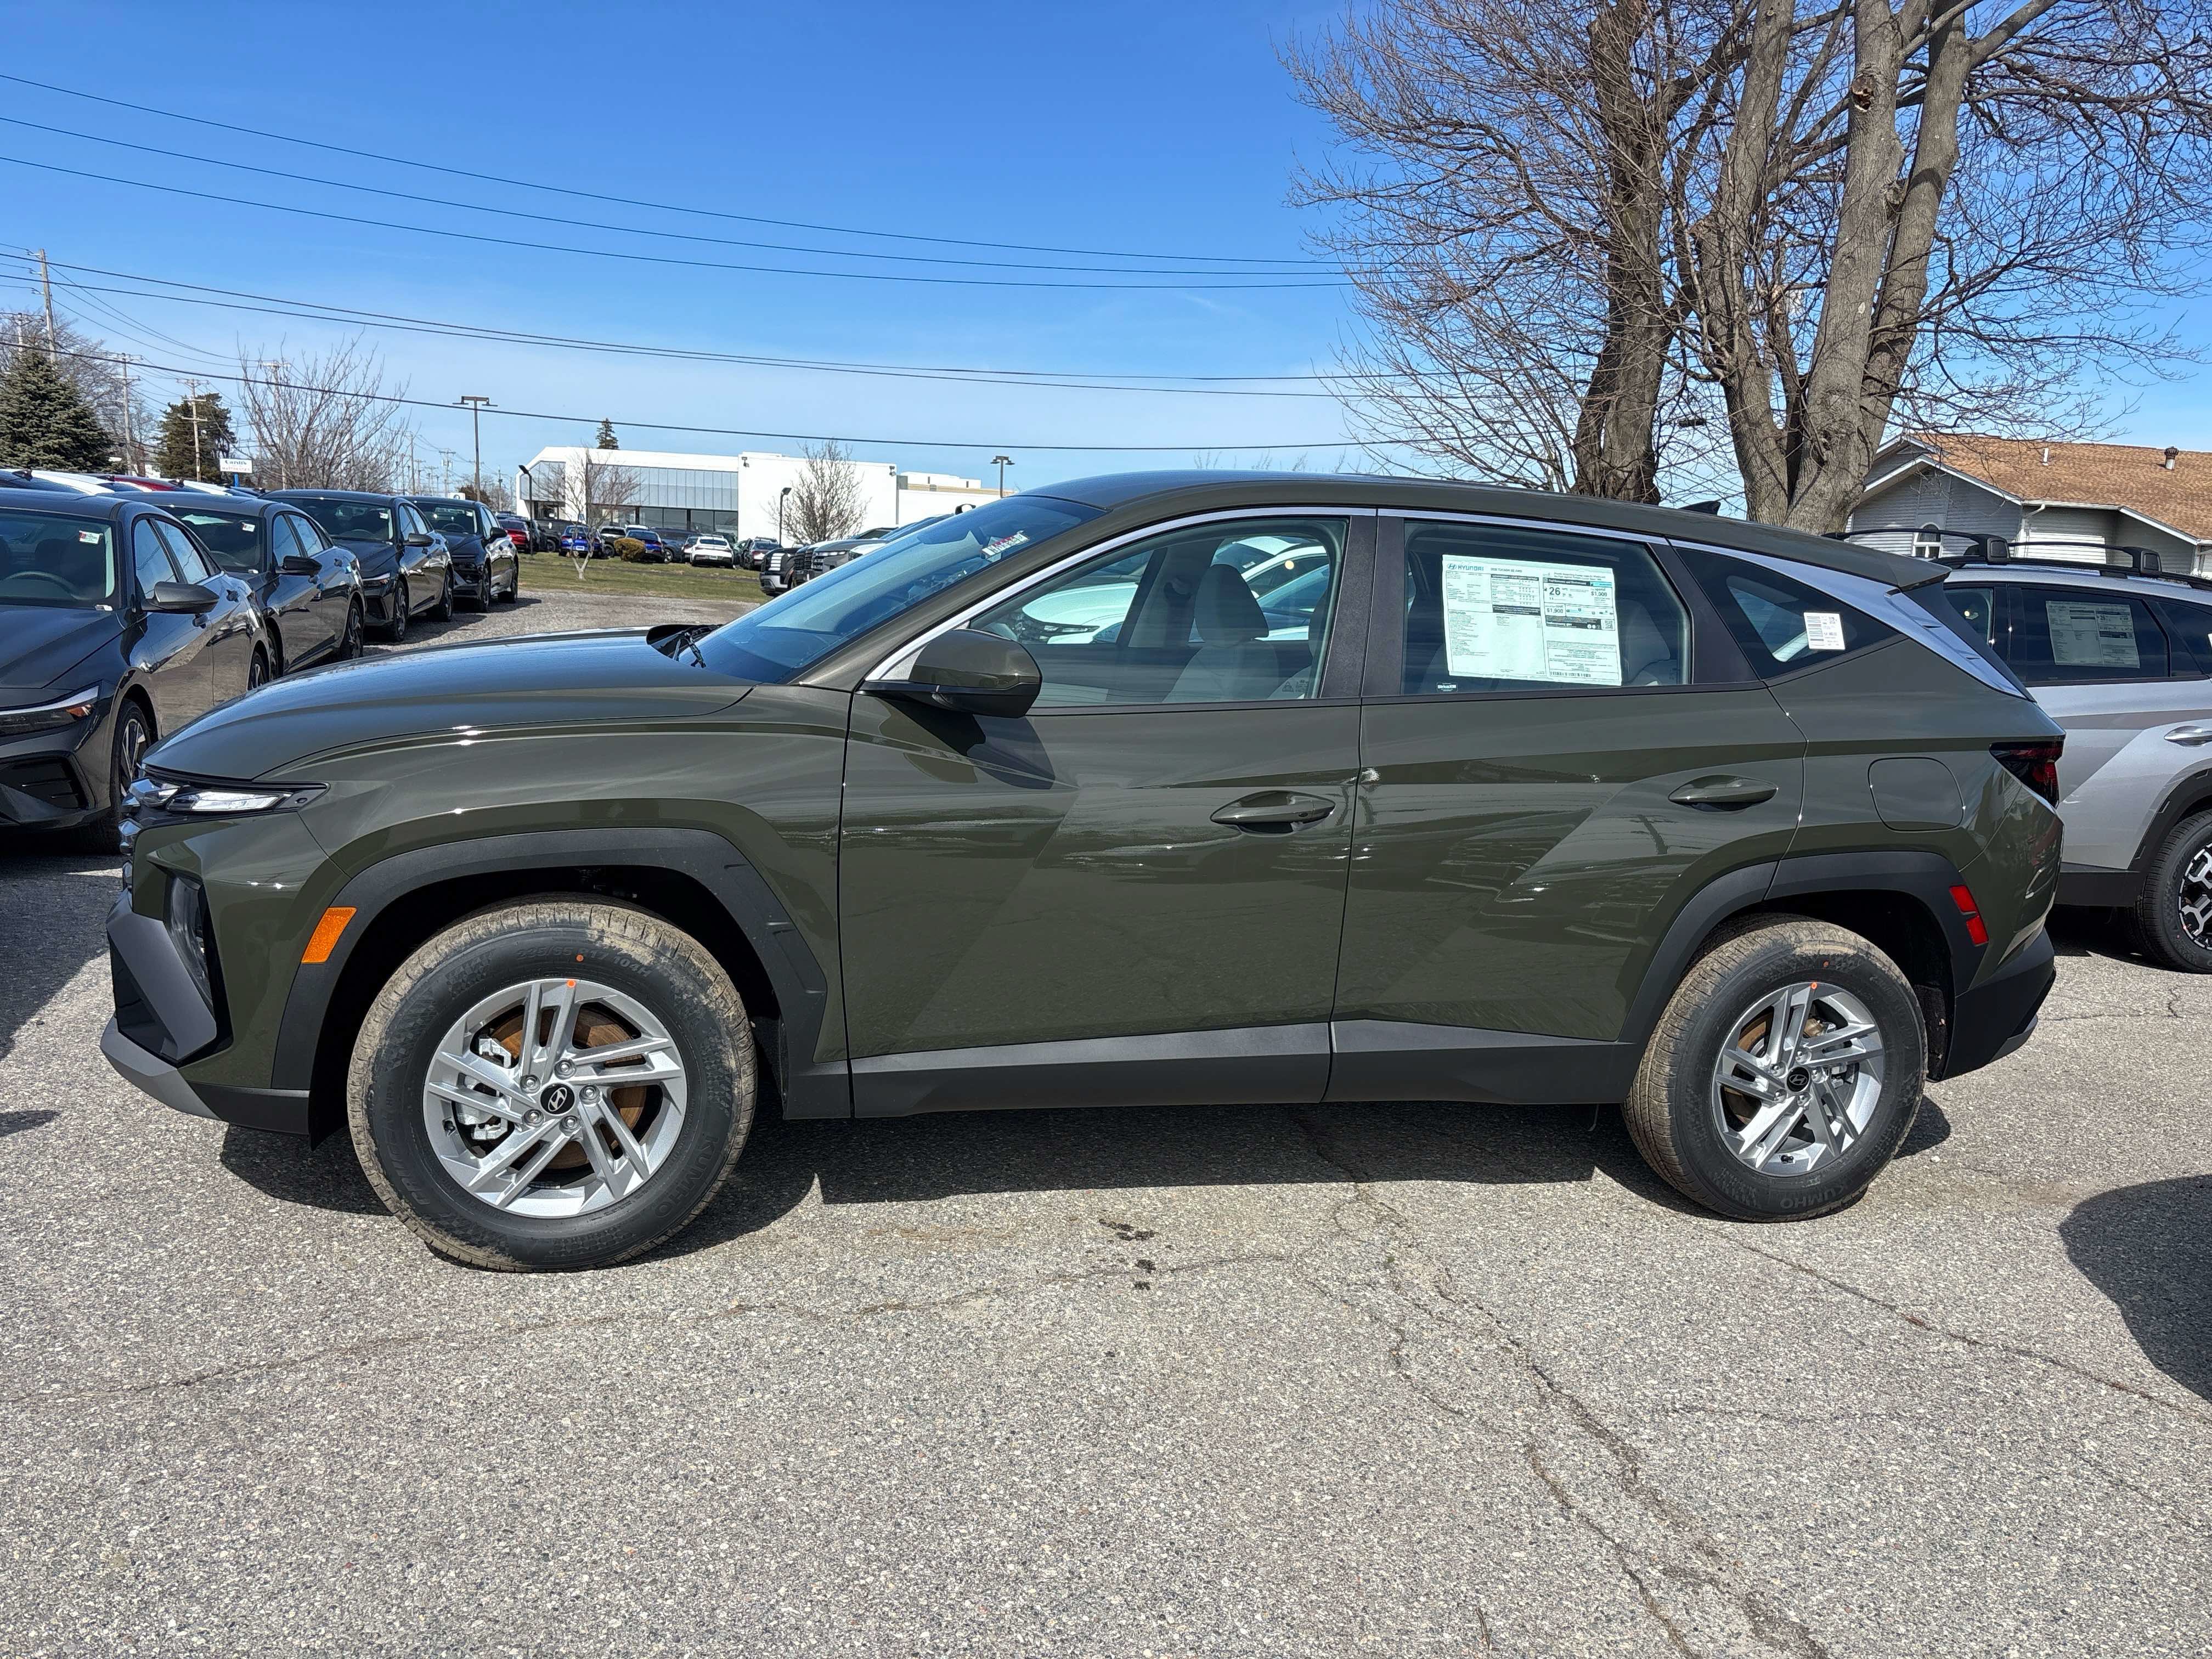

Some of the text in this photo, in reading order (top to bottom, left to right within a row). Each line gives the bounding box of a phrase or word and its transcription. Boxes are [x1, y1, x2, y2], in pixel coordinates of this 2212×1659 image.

[1549, 586, 1561, 596] 26
[613, 956, 653, 977] 104H
[654, 1135, 719, 1218] KUMHO
